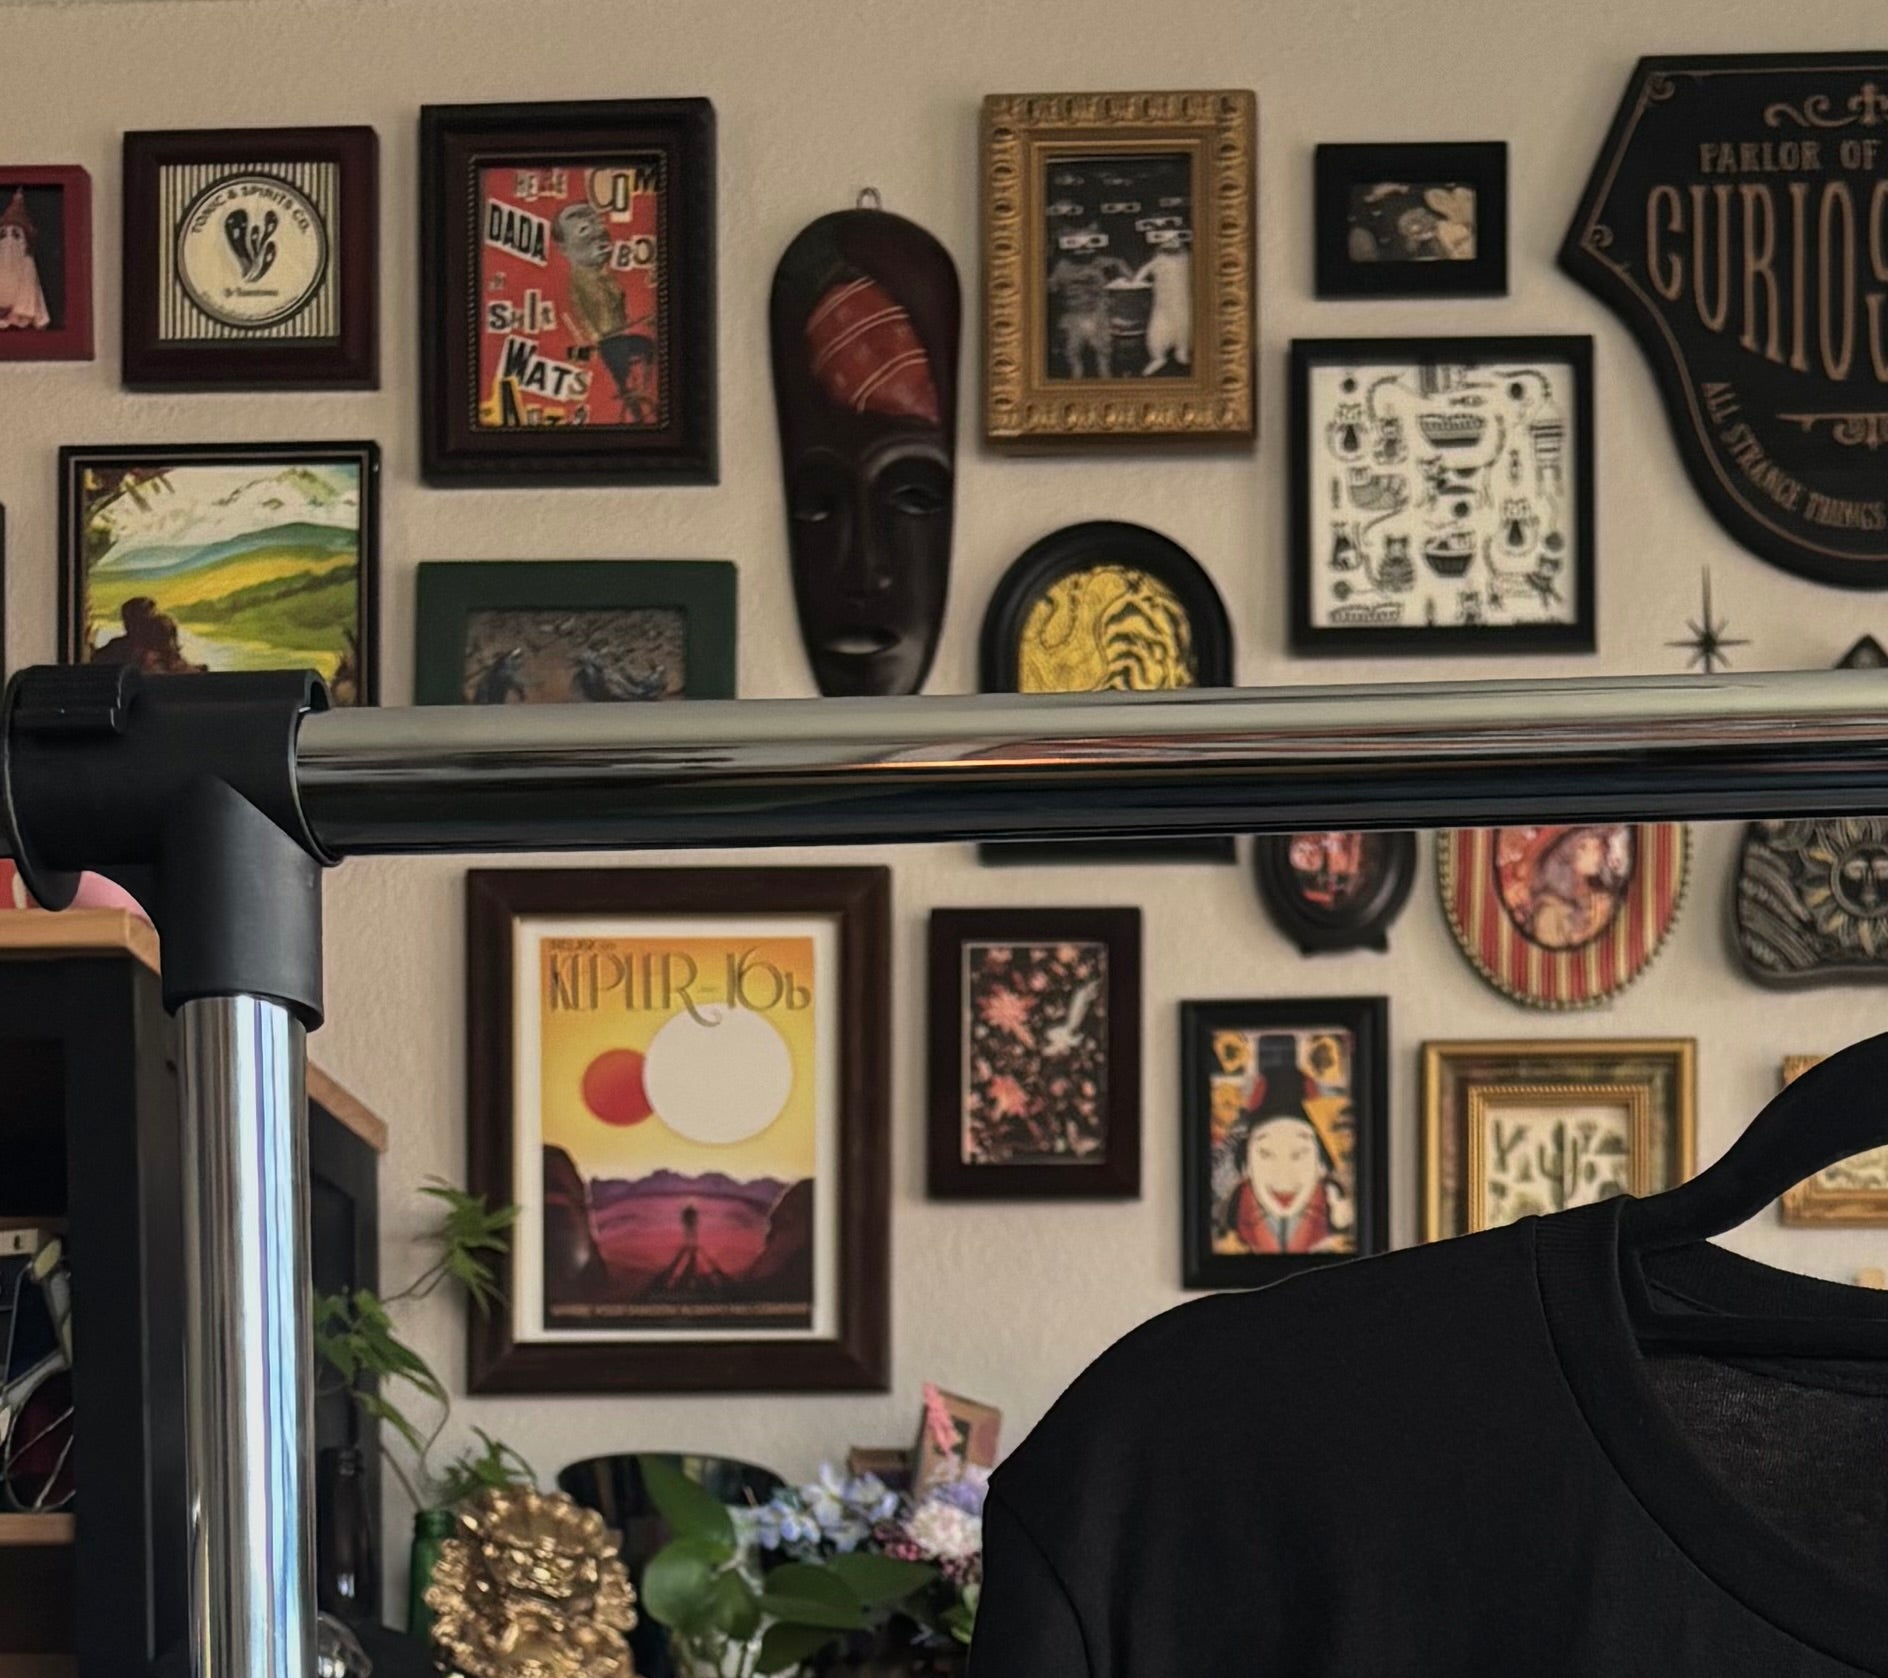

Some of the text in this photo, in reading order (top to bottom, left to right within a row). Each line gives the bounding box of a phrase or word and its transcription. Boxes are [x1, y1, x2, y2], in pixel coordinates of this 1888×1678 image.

[1701, 141, 1821, 173] PARLOR
[1840, 139, 1882, 170] OF
[489, 203, 547, 262] DADA
